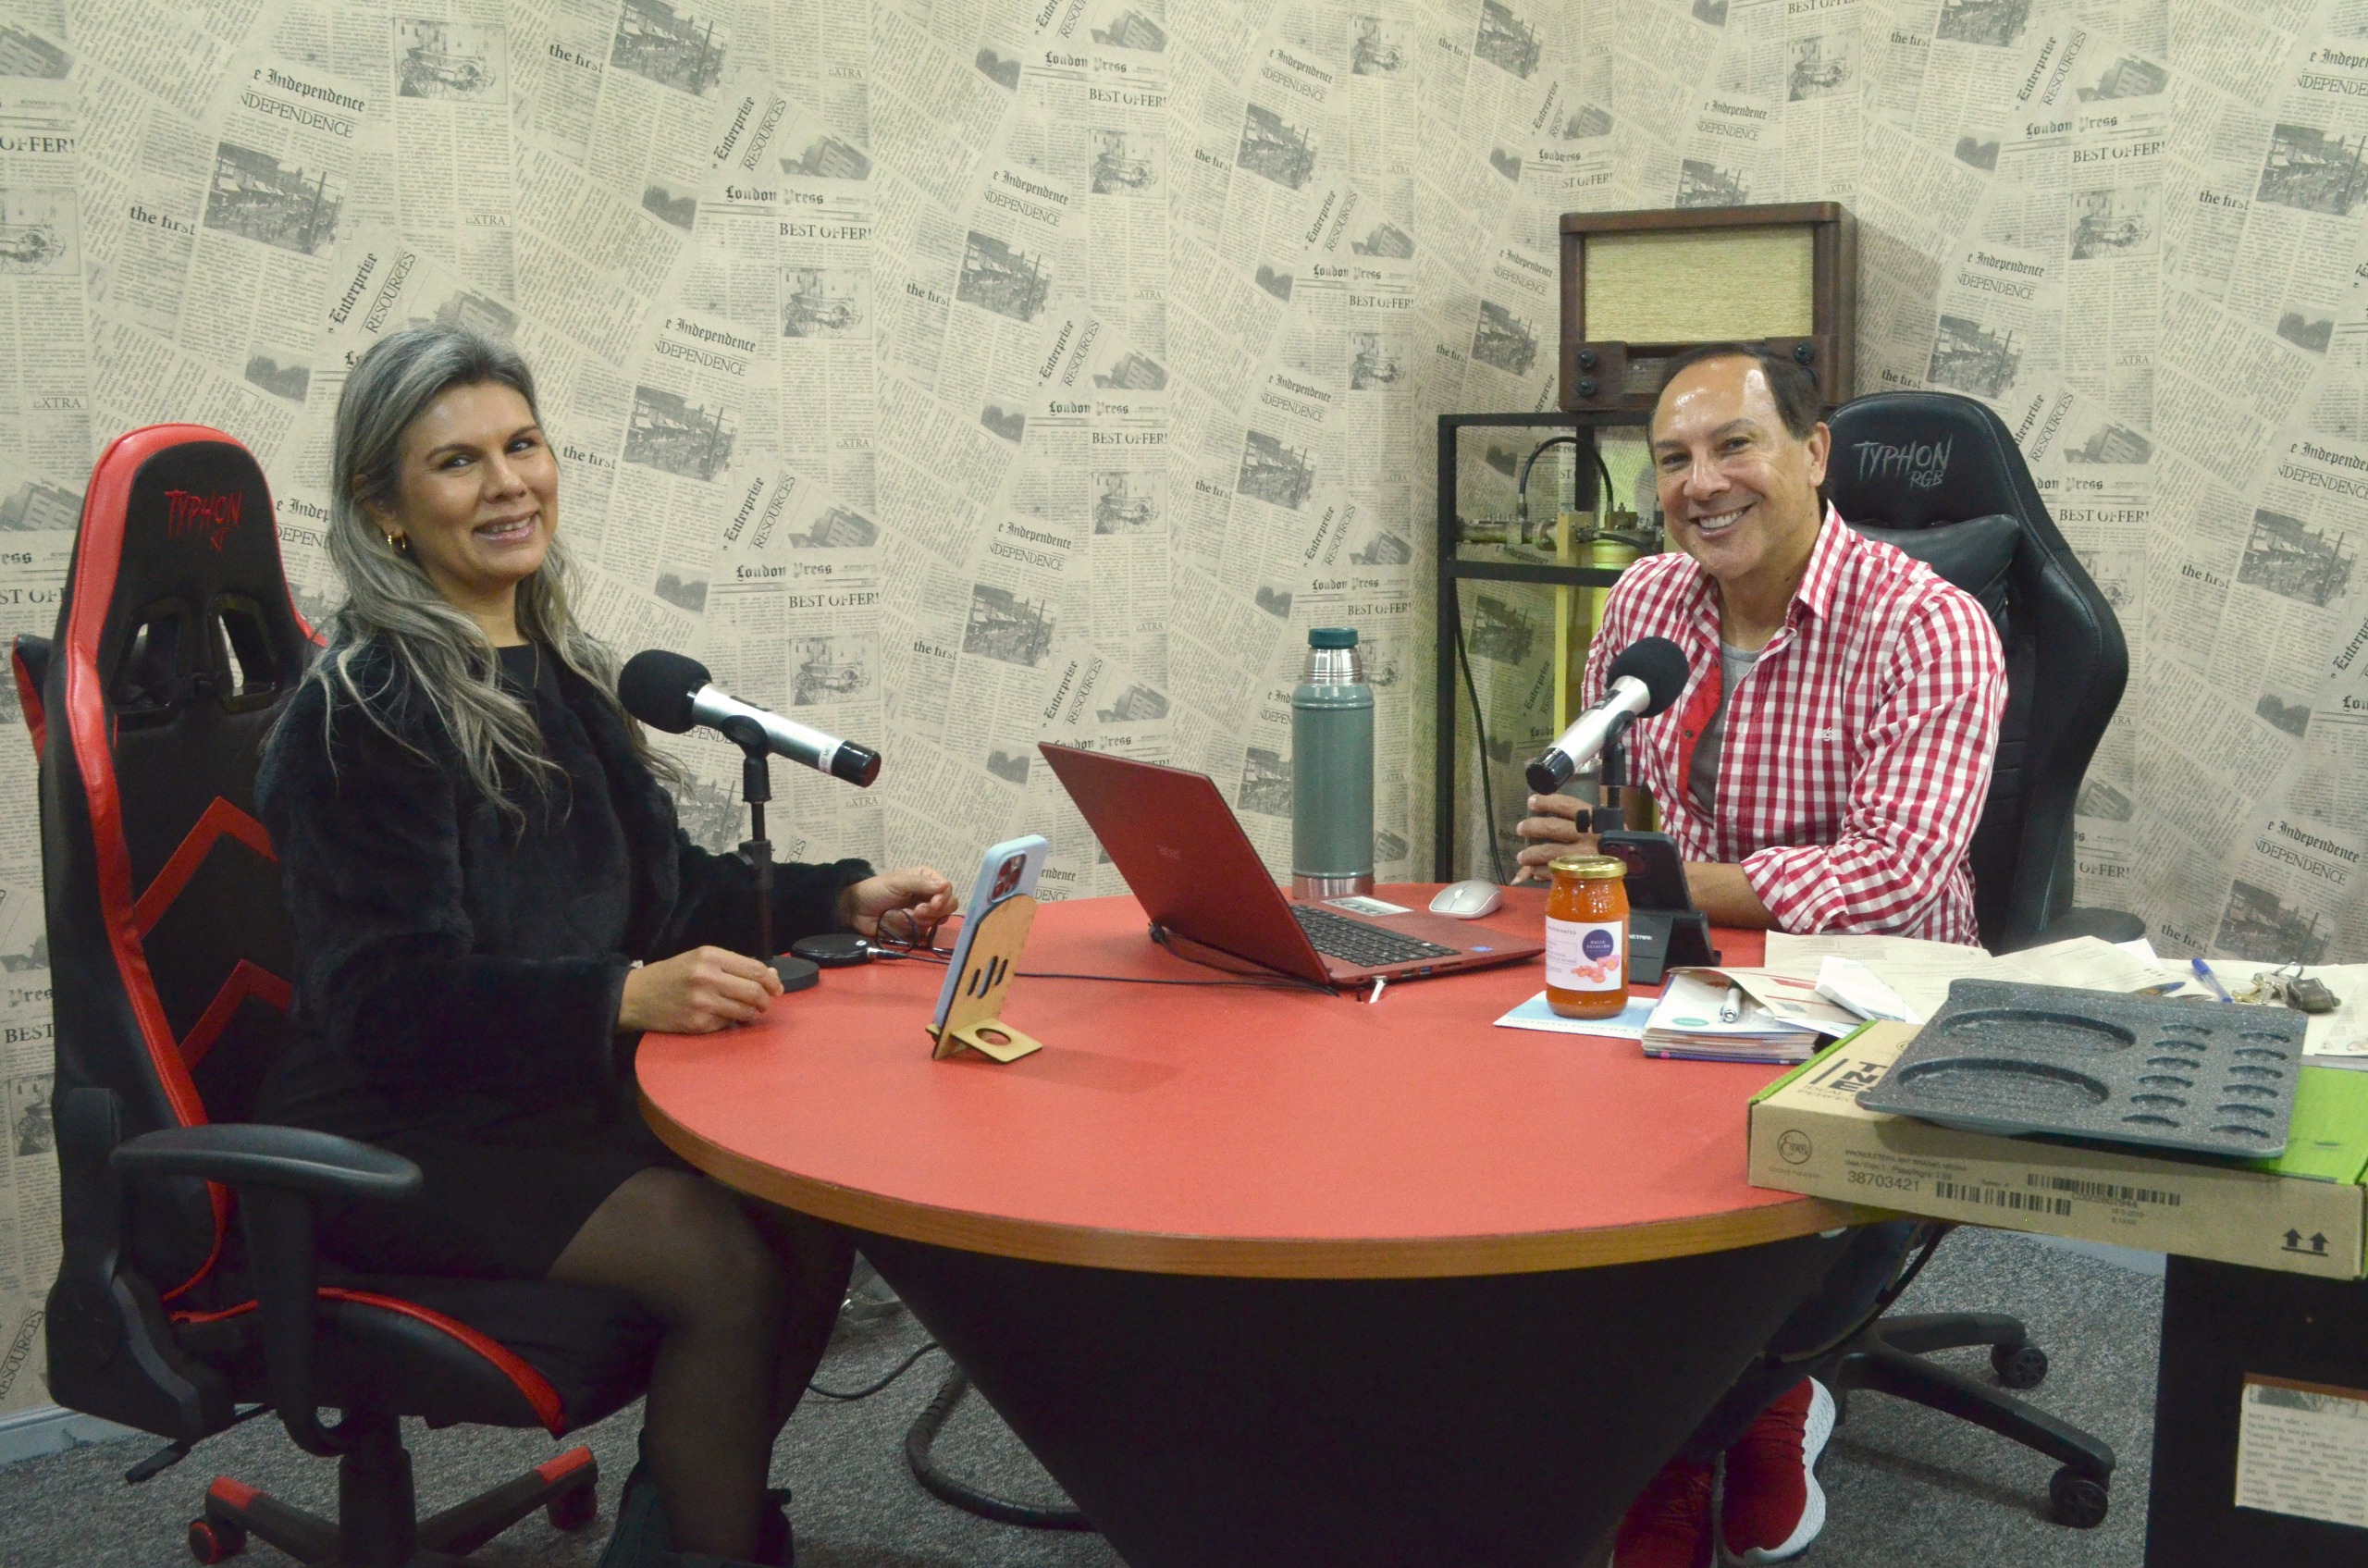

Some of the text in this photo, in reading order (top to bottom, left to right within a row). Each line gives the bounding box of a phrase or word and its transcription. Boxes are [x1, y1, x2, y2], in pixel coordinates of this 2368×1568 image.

[1276, 48, 1333, 85] Independence
[2042, 31, 2088, 107] RESOURCES
[266, 68, 366, 113] Independence
[1089, 88, 1119, 105] BEST
[1712, 100, 1768, 120] Independence
[742, 97, 787, 170] RESOURCES
[2073, 147, 2109, 164] BEST
[1002, 167, 1069, 205] Independence
[779, 222, 814, 238] BEST
[1326, 191, 1358, 253] RESOURCES
[1977, 251, 2045, 278] Independence
[365, 251, 416, 334] RESOURCES
[1350, 296, 1375, 308] BEST
[676, 315, 756, 352] Independence
[1064, 319, 1100, 388] RESOURCES
[1277, 373, 1332, 403] Independence
[1092, 431, 1122, 444] BEST
[2030, 392, 2074, 463] RESOURCES
[1852, 431, 1954, 481] TYPHON
[1909, 470, 1944, 488] RGB
[165, 488, 242, 539] TYPHON
[753, 475, 796, 549] RESOURCES
[2059, 509, 2091, 522] BEST
[1006, 522, 1072, 549] Independence
[1326, 505, 1356, 565] RESOURCES
[788, 593, 825, 609] BEST
[1348, 603, 1373, 617] BEST
[1067, 658, 1104, 725] RESOURCES
[2280, 820, 2361, 863] Independence
[8, 987, 52, 1007] Pres
[1847, 1171, 1919, 1191] 38703421
[0, 1309, 44, 1400] ESOURCES
